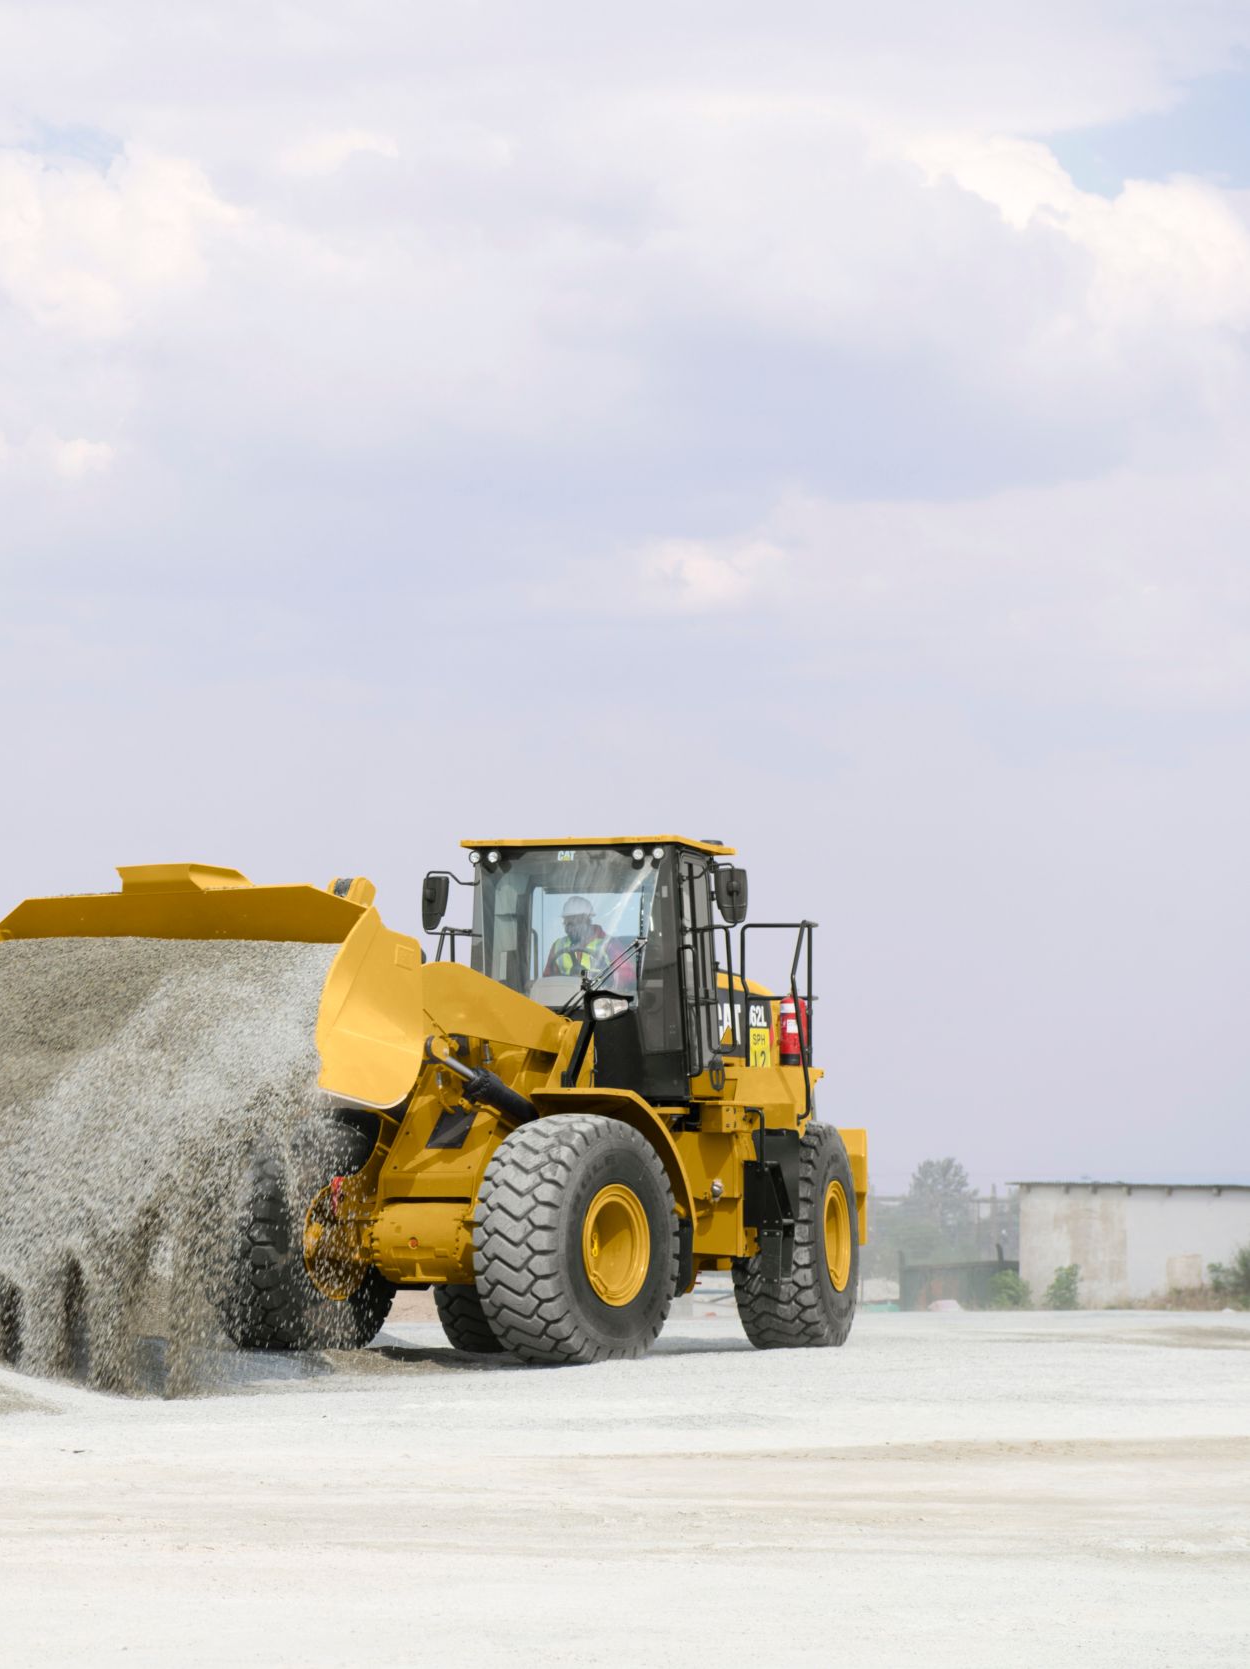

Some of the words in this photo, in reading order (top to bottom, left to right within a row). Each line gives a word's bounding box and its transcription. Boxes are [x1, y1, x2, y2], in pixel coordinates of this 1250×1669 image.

[557, 850, 575, 861] CAT
[748, 1004, 767, 1027] 62L
[752, 1033, 765, 1045] SPH
